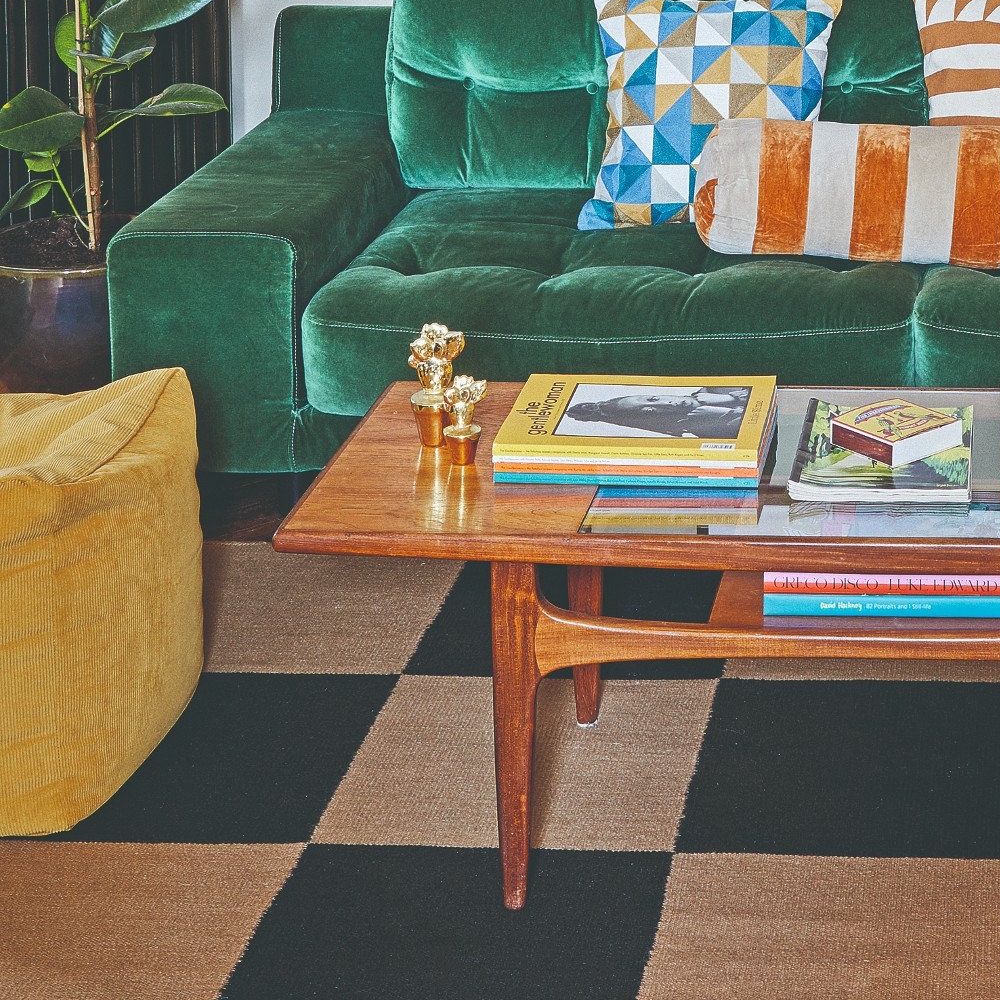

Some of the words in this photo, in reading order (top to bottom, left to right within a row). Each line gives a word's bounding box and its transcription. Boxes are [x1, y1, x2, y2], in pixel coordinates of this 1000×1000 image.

[516, 402, 541, 415] the
[528, 382, 567, 436] gentlewoman
[774, 576, 828, 590] GRECO
[832, 577, 879, 590] DISCO
[888, 578, 929, 591] LUKE
[933, 579, 998, 592] EDWARD
[820, 601, 836, 609] David
[837, 601, 863, 611] Hockney
